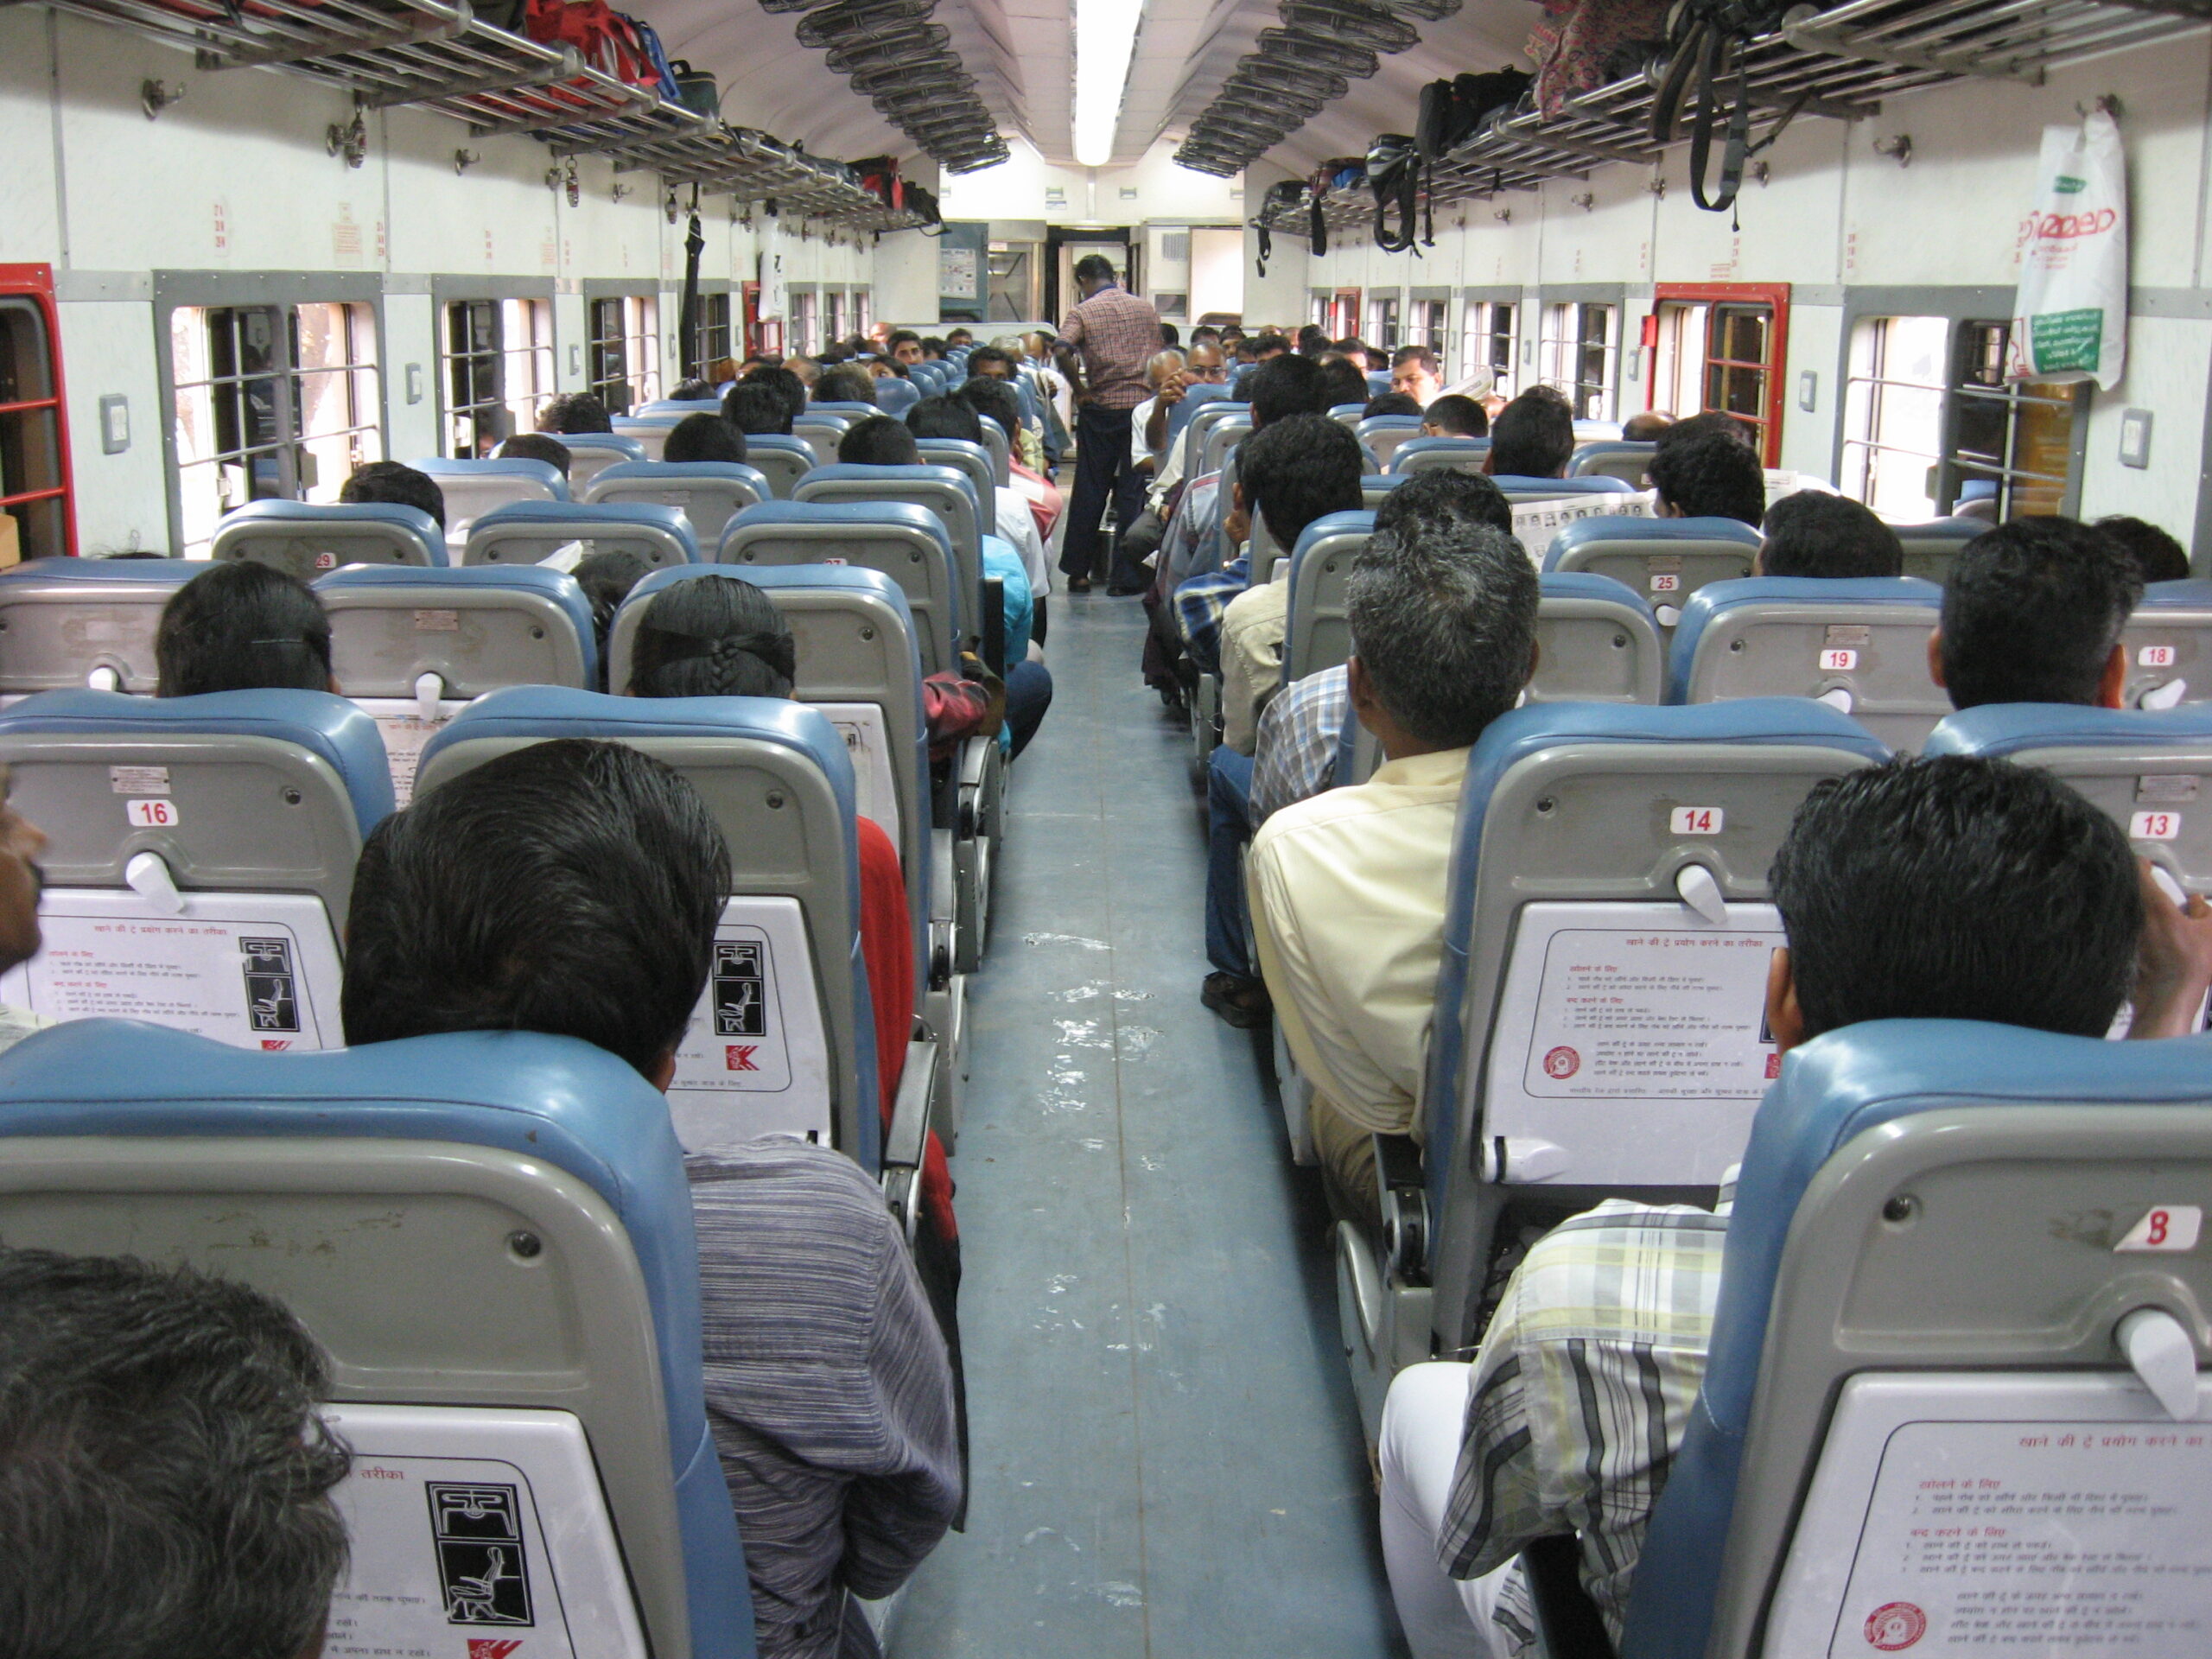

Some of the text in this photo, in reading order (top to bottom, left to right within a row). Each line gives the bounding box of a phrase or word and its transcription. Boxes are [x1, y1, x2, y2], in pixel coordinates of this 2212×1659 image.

[1657, 576, 1674, 589] 25
[1830, 652, 1850, 668] 19
[2149, 649, 2167, 664] 18
[140, 802, 168, 824] 16
[1685, 810, 1713, 831] 14
[2145, 814, 2170, 836] 13
[1648, 937, 1660, 946] की
[1700, 938, 1719, 947] करने
[1738, 938, 1764, 948] तरीका
[2146, 1210, 2169, 1246] 8
[2018, 1435, 2049, 1448] खाने
[2056, 1433, 2075, 1448] की
[2145, 1435, 2177, 1447] करने
[2185, 1436, 2203, 1447] का
[361, 1466, 405, 1480] तरीका
